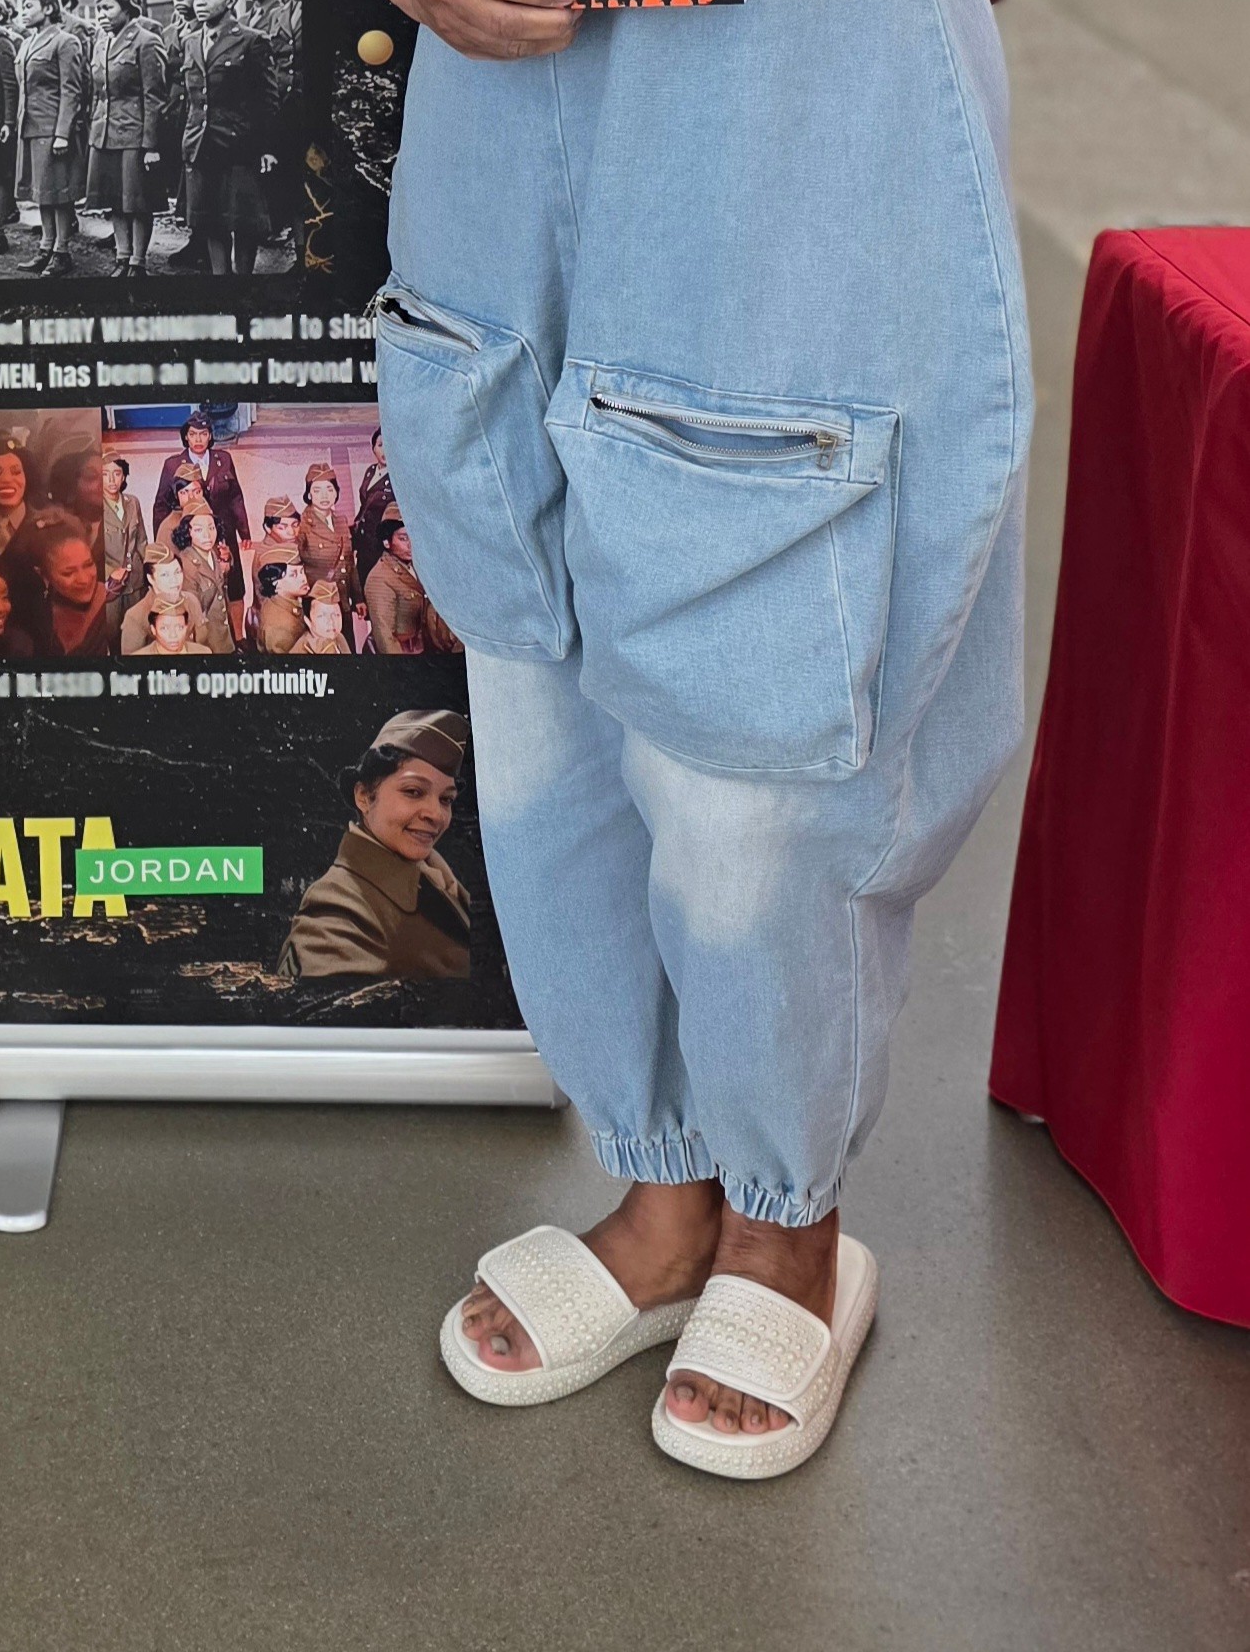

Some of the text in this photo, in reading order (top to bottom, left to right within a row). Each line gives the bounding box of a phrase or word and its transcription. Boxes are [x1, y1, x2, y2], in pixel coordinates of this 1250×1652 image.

[30, 317, 94, 344] KERRY
[300, 314, 323, 339] to
[49, 362, 90, 388] has
[197, 669, 334, 698] opportunity.
[90, 858, 245, 884] JORDAN
